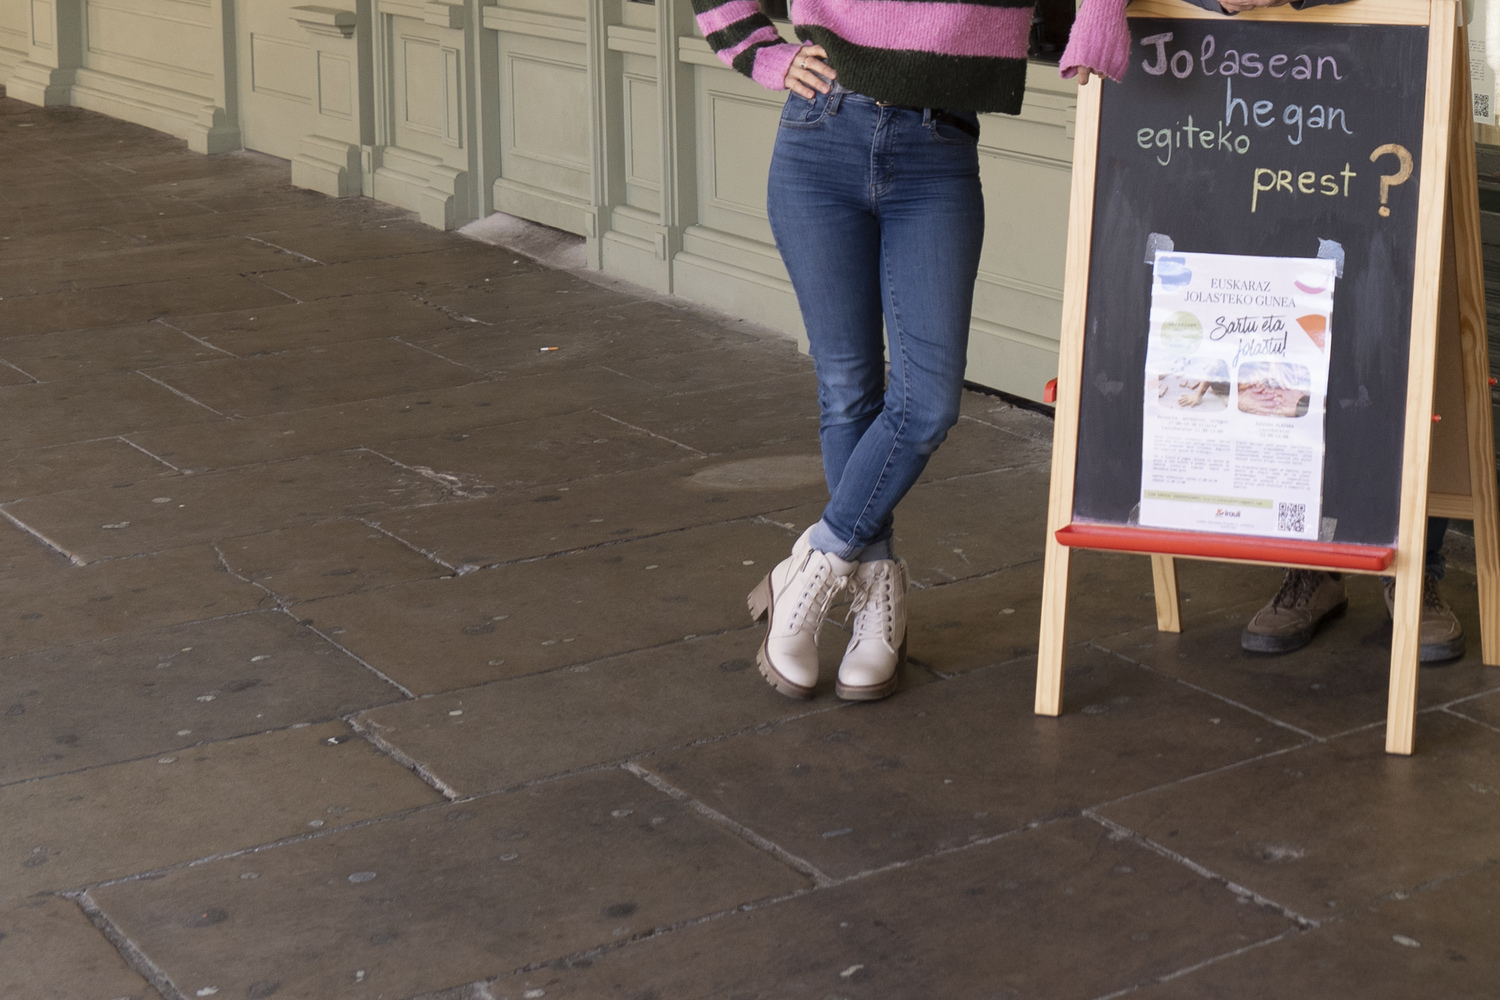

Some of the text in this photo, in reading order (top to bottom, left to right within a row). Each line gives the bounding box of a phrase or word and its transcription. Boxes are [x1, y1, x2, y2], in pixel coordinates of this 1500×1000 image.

[1139, 31, 1343, 80] Jolasean
[1136, 114, 1251, 166] egiteko
[1211, 277, 1272, 293] EUSKARAZ
[1184, 290, 1297, 309] JOLASTEKO GUNEA
[1209, 315, 1261, 341] Sartu
[1261, 314, 1286, 333] eta
[1232, 330, 1288, 367] jolastu!
[1223, 508, 1242, 518] irauli
